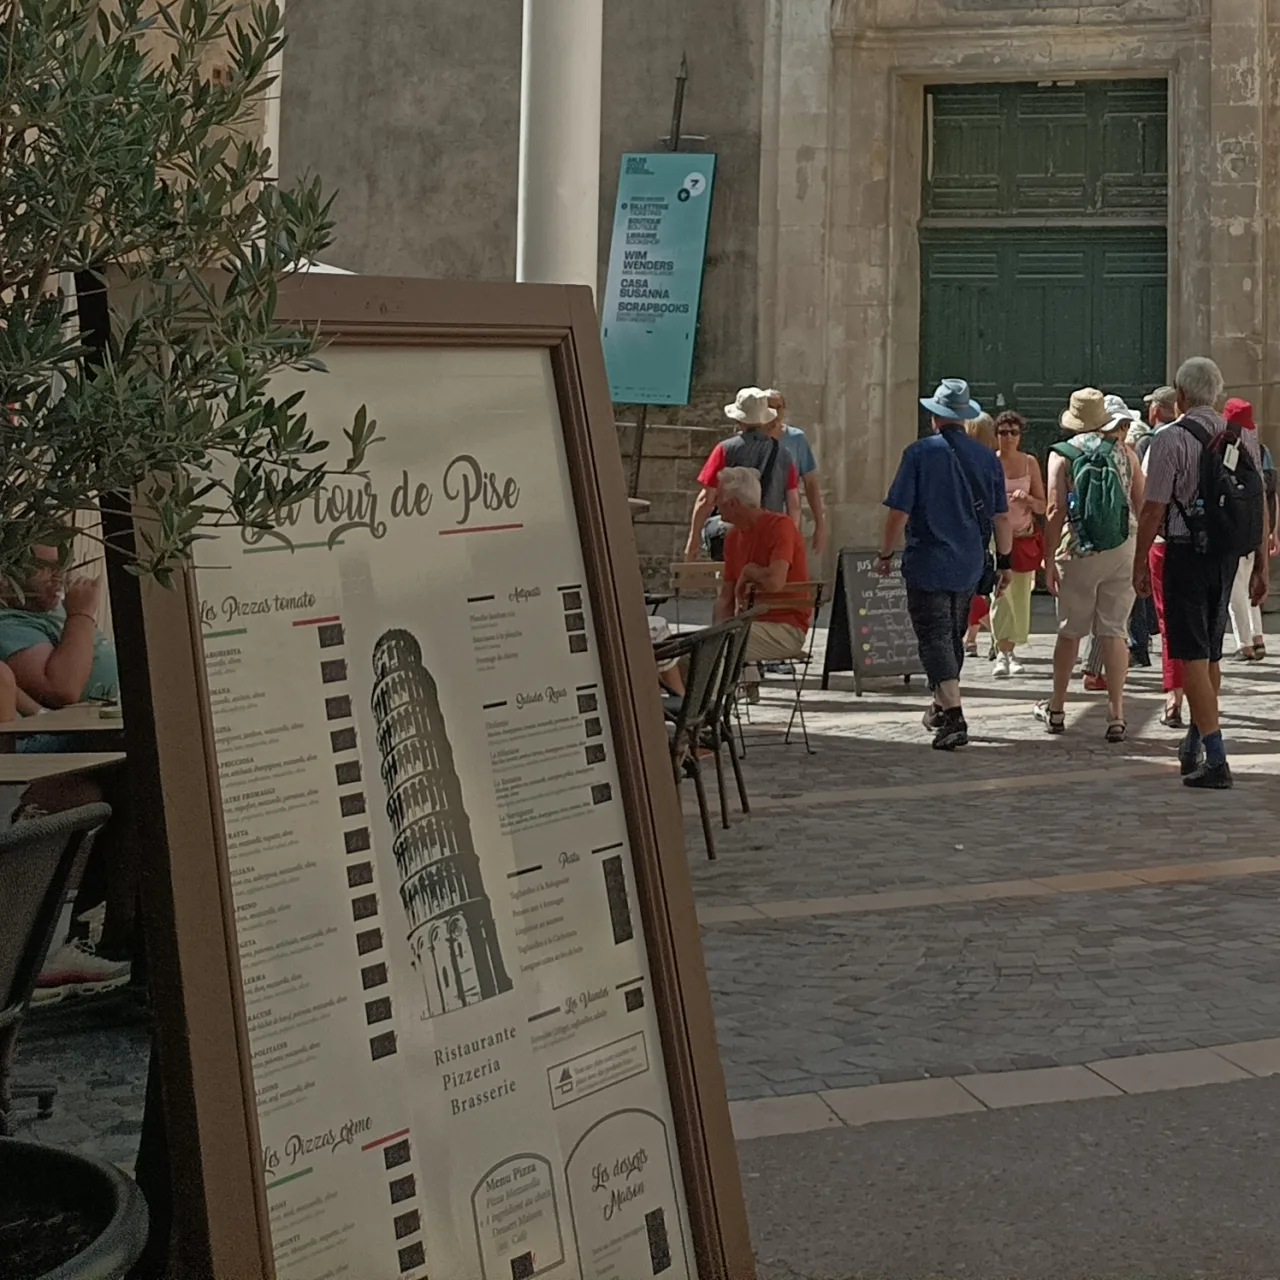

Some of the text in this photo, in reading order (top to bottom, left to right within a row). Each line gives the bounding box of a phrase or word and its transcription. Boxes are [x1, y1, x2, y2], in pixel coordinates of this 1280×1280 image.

[623, 260, 674, 271] WENDERS
[624, 250, 648, 260] WIM
[619, 288, 670, 299] SUSANNA
[620, 278, 649, 289] CASA
[617, 301, 690, 314] SCRAPBOOKS
[314, 480, 387, 551] tour
[391, 470, 433, 518] de
[443, 454, 521, 525] Pise
[856, 559, 872, 572] JUS
[198, 591, 317, 629] Les Pizzas tomato
[434, 1025, 517, 1067] Ristaurante
[443, 1058, 501, 1091] Pizzeria
[450, 1078, 517, 1116] Brasserie
[263, 1146, 281, 1177] Les
[284, 1128, 337, 1166] Pizzas
[485, 1163, 537, 1193] Menu Pizza
[591, 1162, 610, 1192] Les
[603, 1181, 645, 1221] Maison
